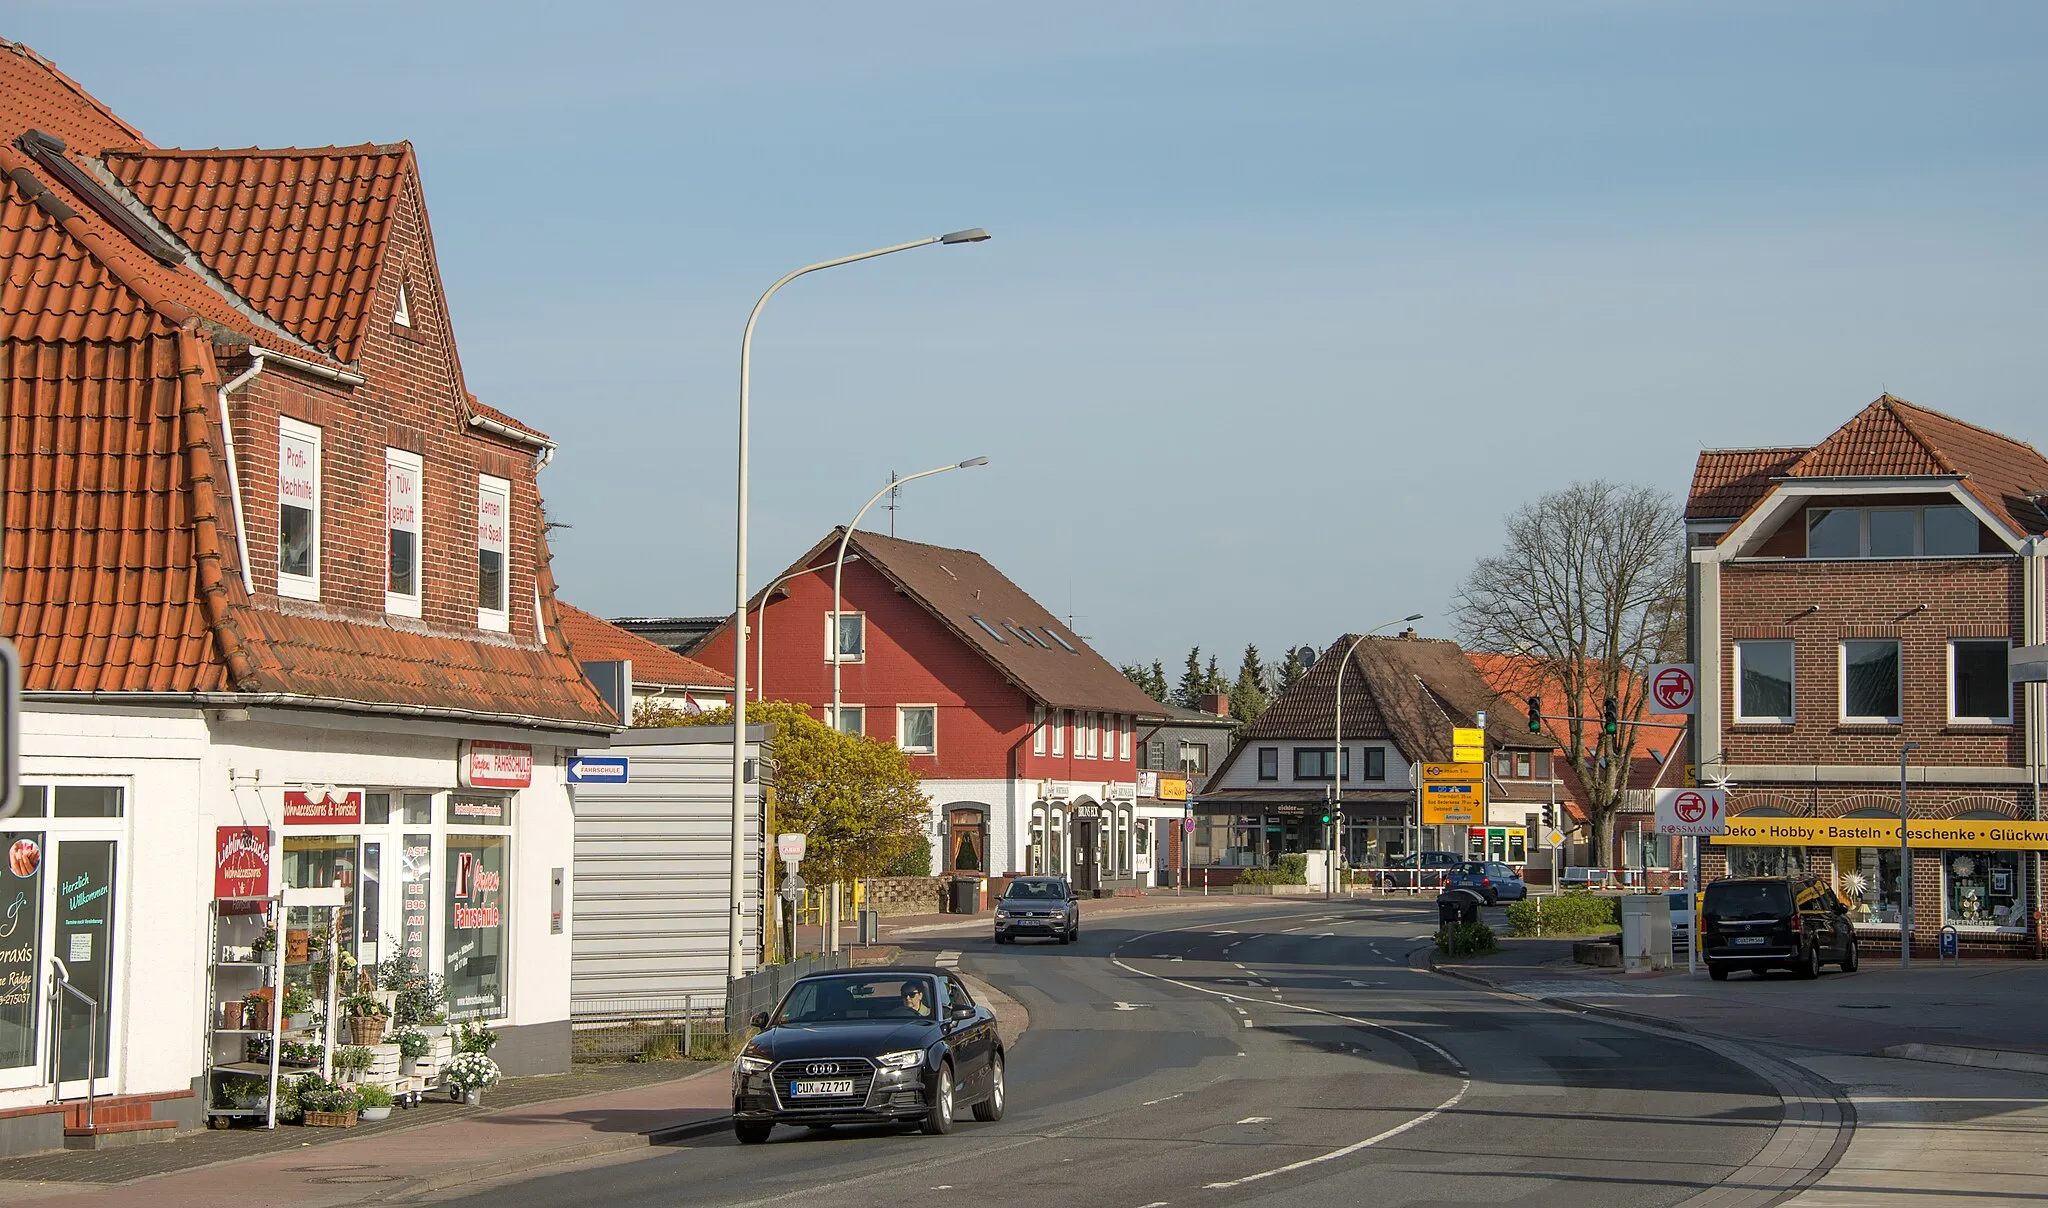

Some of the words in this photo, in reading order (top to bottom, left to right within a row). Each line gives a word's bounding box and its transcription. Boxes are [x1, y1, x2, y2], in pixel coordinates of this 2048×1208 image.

[287, 447, 306, 468] Profi-
[280, 474, 312, 500] Nachhilfe
[396, 473, 411, 495] TÜV-
[481, 497, 500, 516] Lernen
[392, 505, 414, 525] geprüft
[488, 524, 502, 544] Spaß
[494, 755, 530, 773] FAHRSCHULE
[1661, 825, 1719, 834] ROSSMANN
[1724, 825, 1757, 837] Deko
[1770, 825, 1814, 840] Hobby
[1828, 826, 1881, 839] Basteln
[407, 847, 427, 857] ASF
[413, 868, 420, 878] B
[62, 872, 89, 895] Herzlich
[409, 884, 423, 894] BE
[69, 885, 108, 911] Willkommen
[406, 900, 425, 910] B96
[407, 916, 424, 925] AM
[454, 902, 499, 929] Fahrschule
[409, 931, 420, 941] A1
[1943, 933, 1953, 946] P
[408, 947, 422, 957] A2
[797, 1082, 815, 1093] CUX
[820, 1082, 832, 1092] ZZ
[834, 1081, 851, 1092] 717
